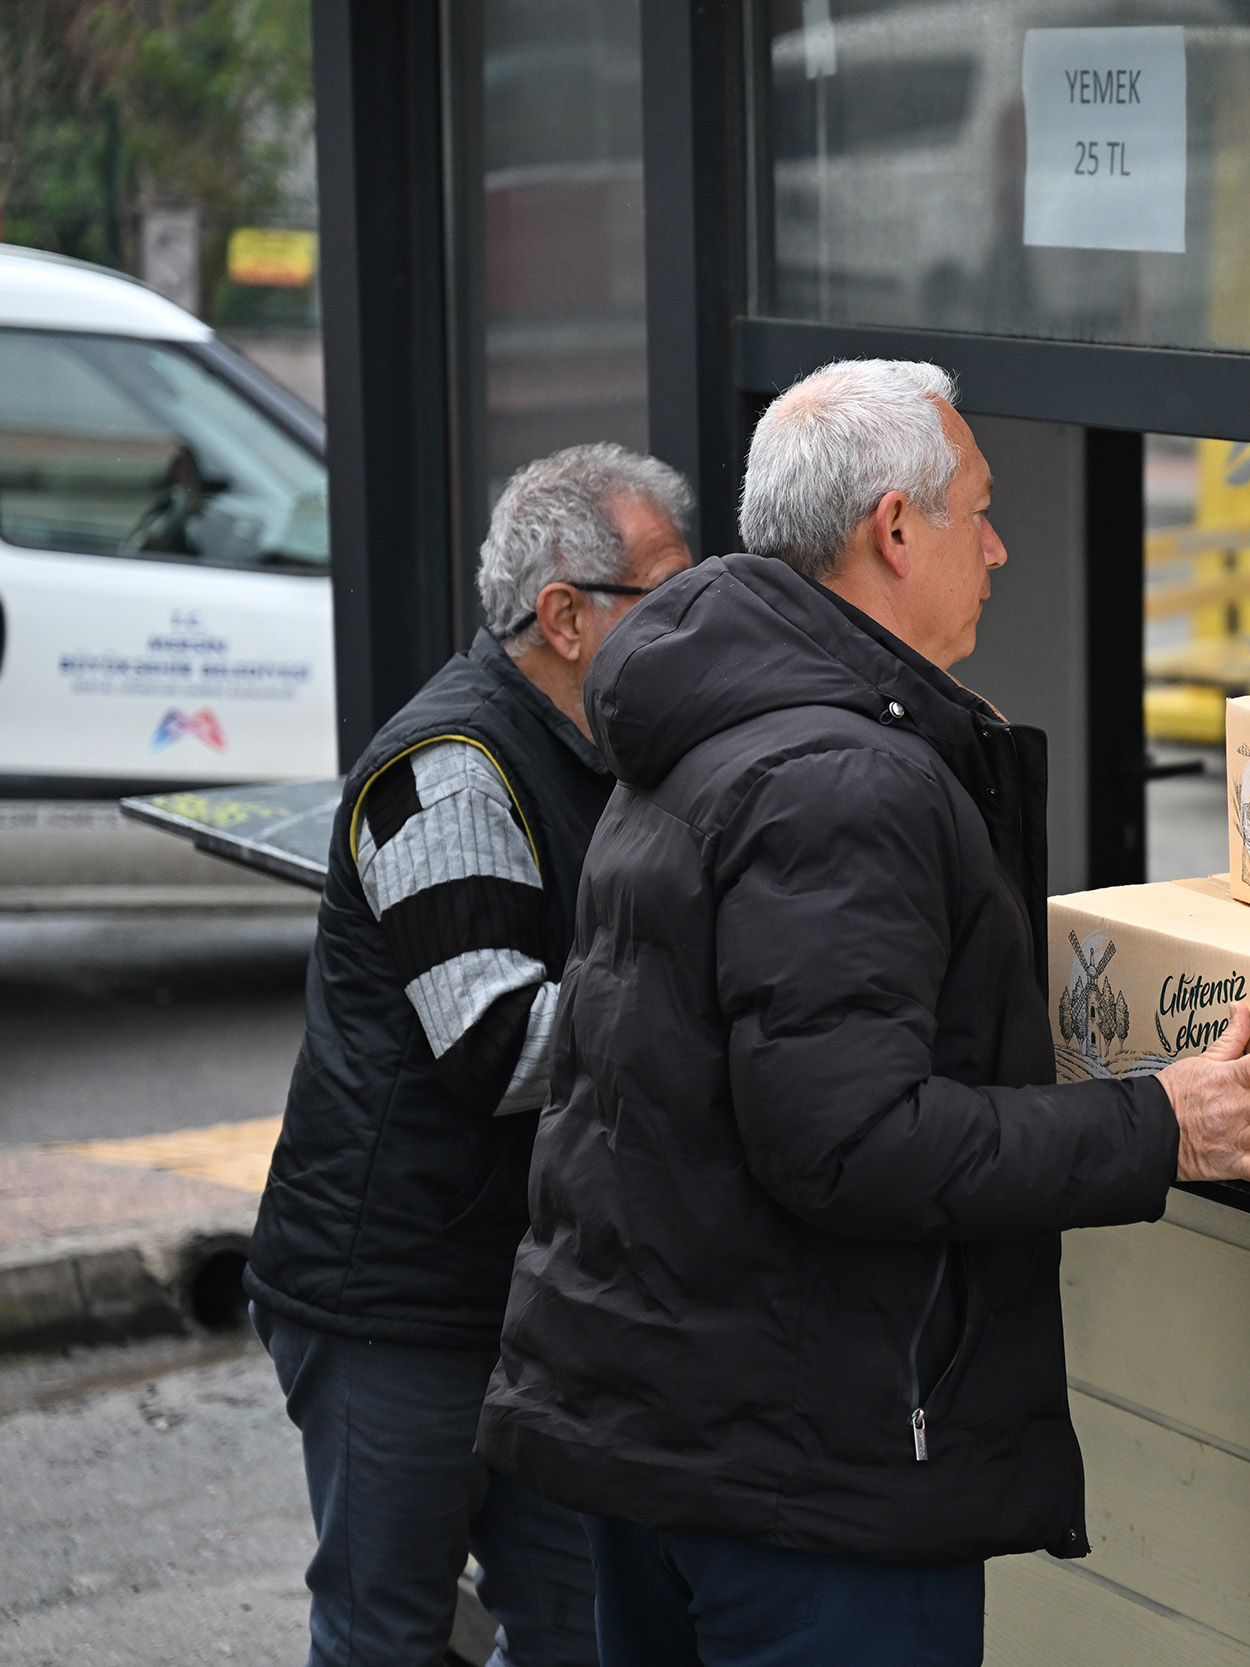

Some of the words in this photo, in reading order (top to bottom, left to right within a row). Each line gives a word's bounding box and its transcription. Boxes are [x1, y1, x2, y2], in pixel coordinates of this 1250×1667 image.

[1065, 69, 1141, 104] YEMEK
[1074, 141, 1099, 175] 25
[1107, 141, 1131, 176] TL
[1177, 1011, 1229, 1053] ekme
